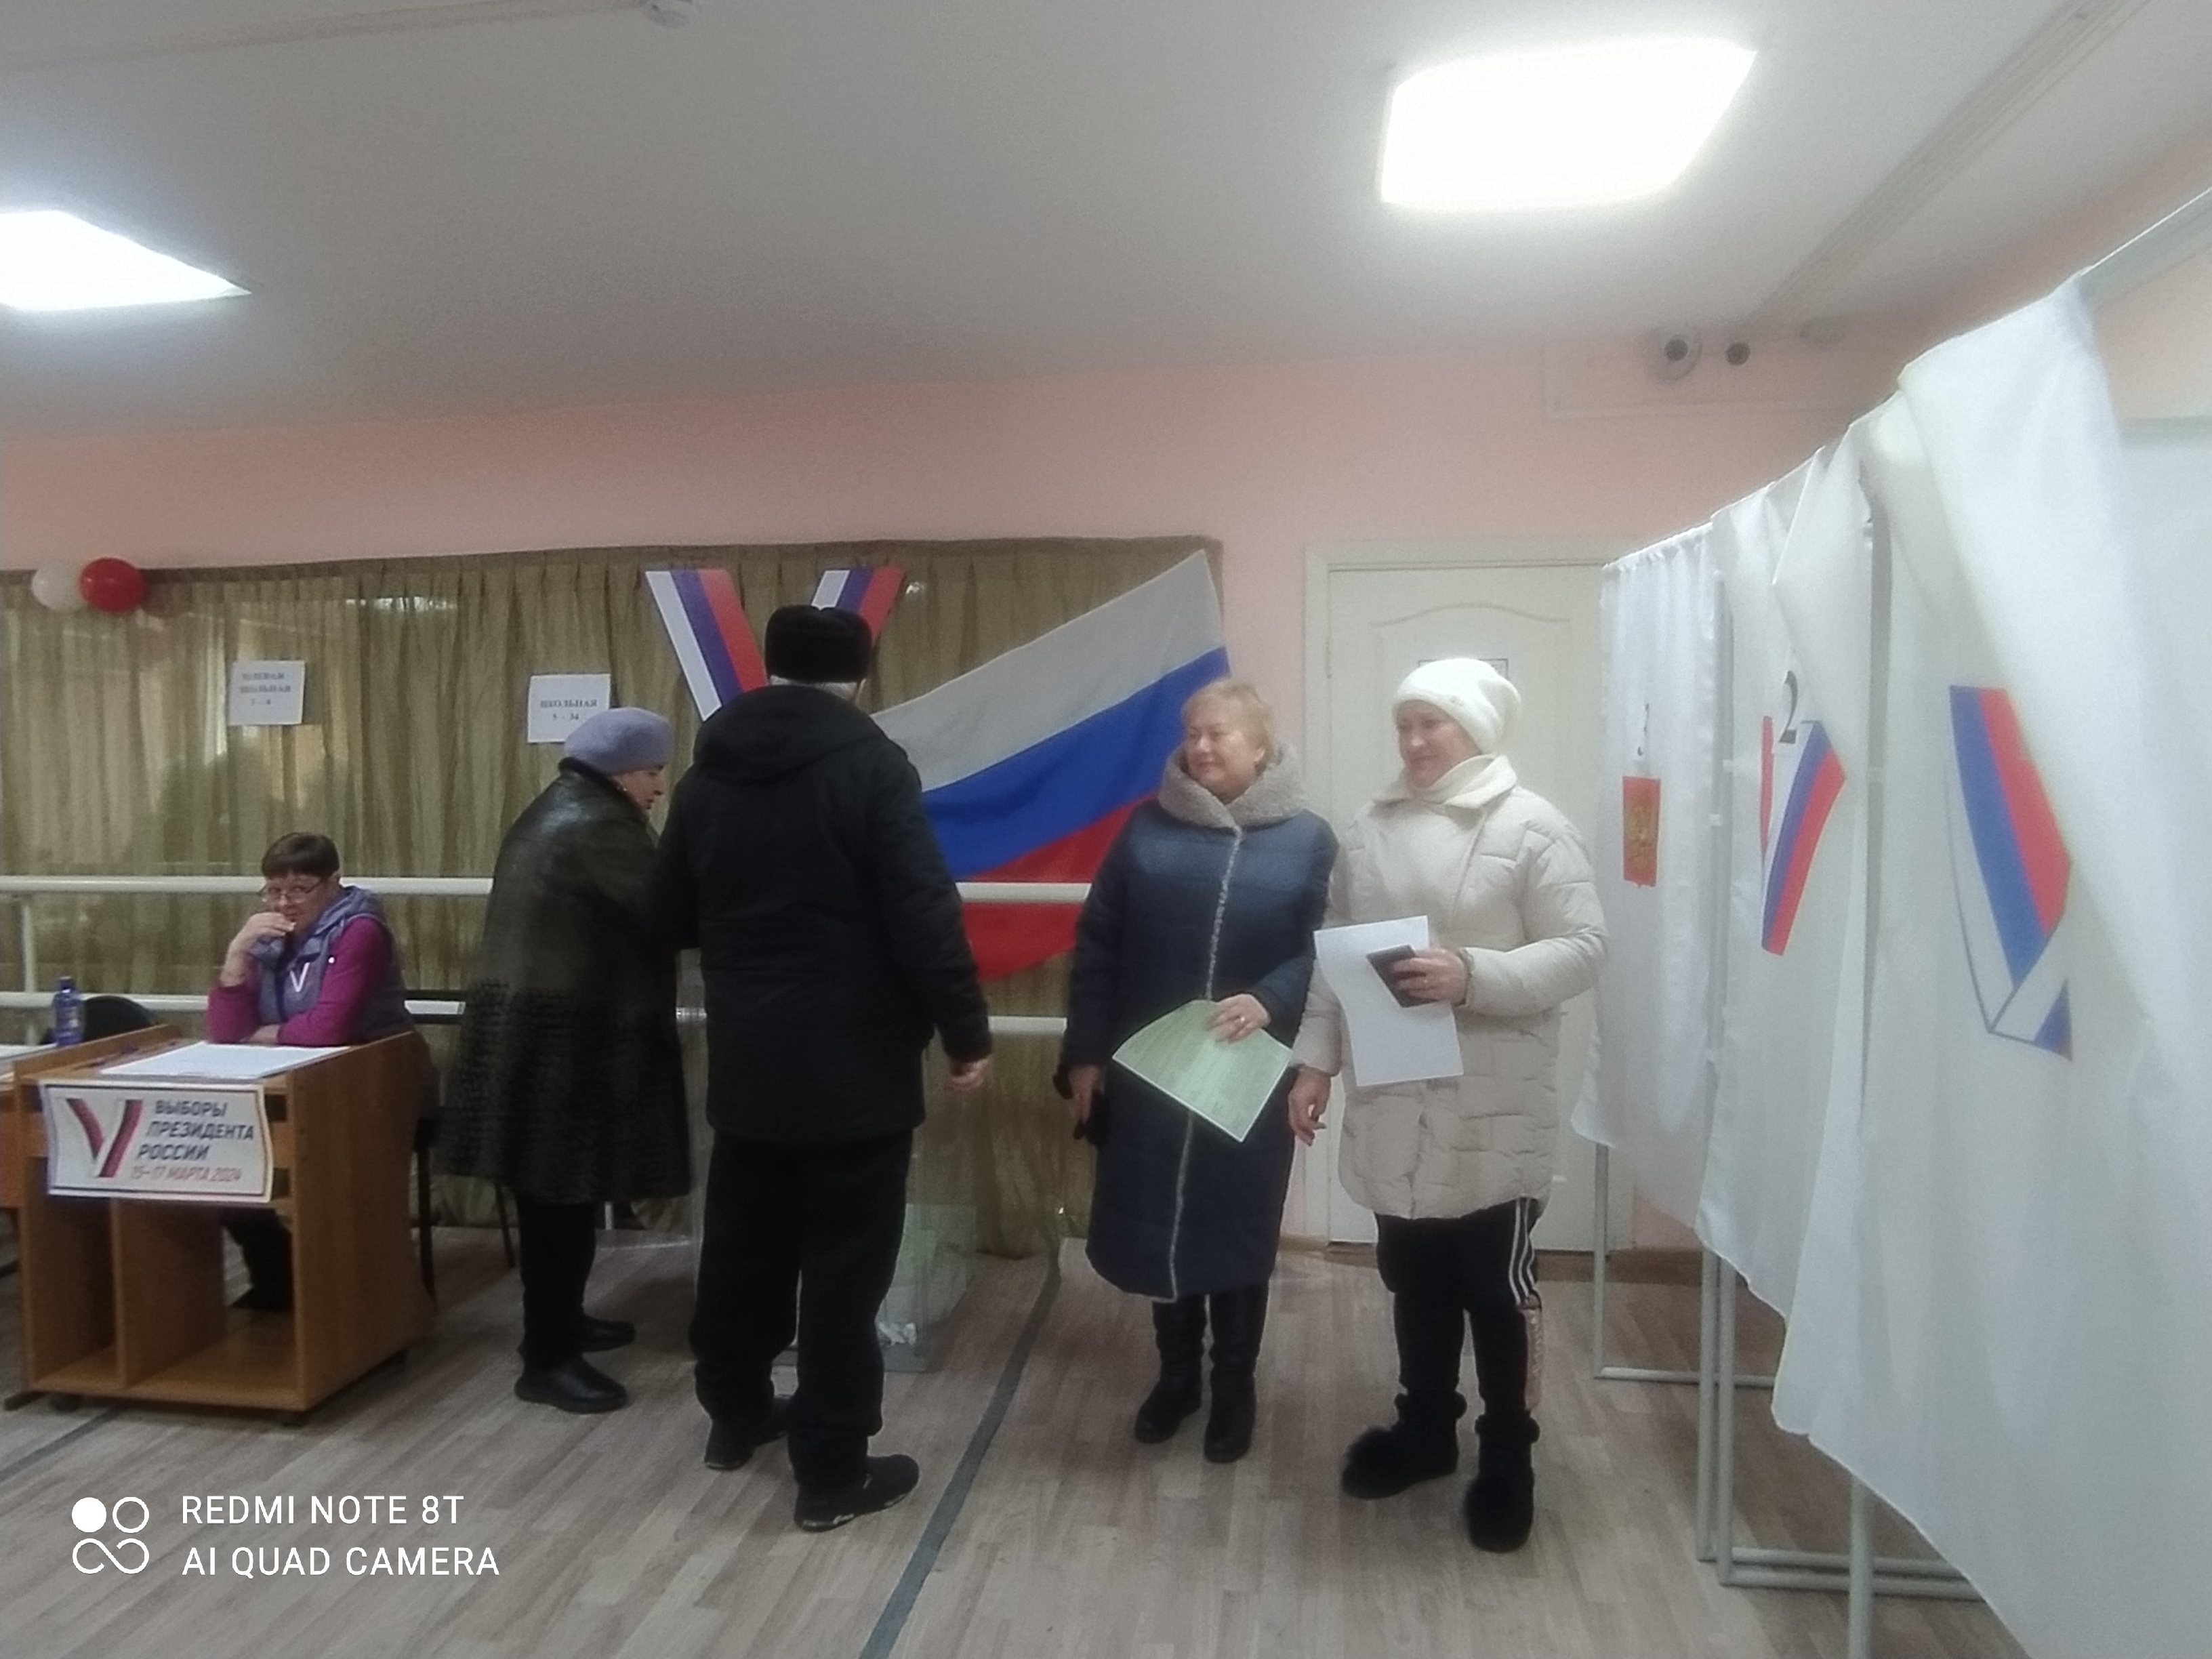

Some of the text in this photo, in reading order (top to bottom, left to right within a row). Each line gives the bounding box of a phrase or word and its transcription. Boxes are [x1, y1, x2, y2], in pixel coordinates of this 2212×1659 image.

[155, 1099, 228, 1118] ВЫБОРЫ
[146, 1120, 254, 1140] ПРЕЗИДЕНТА
[136, 1143, 211, 1161] РОССИИ
[165, 1166, 209, 1181] МАРТА
[209, 1167, 243, 1182] 2024
